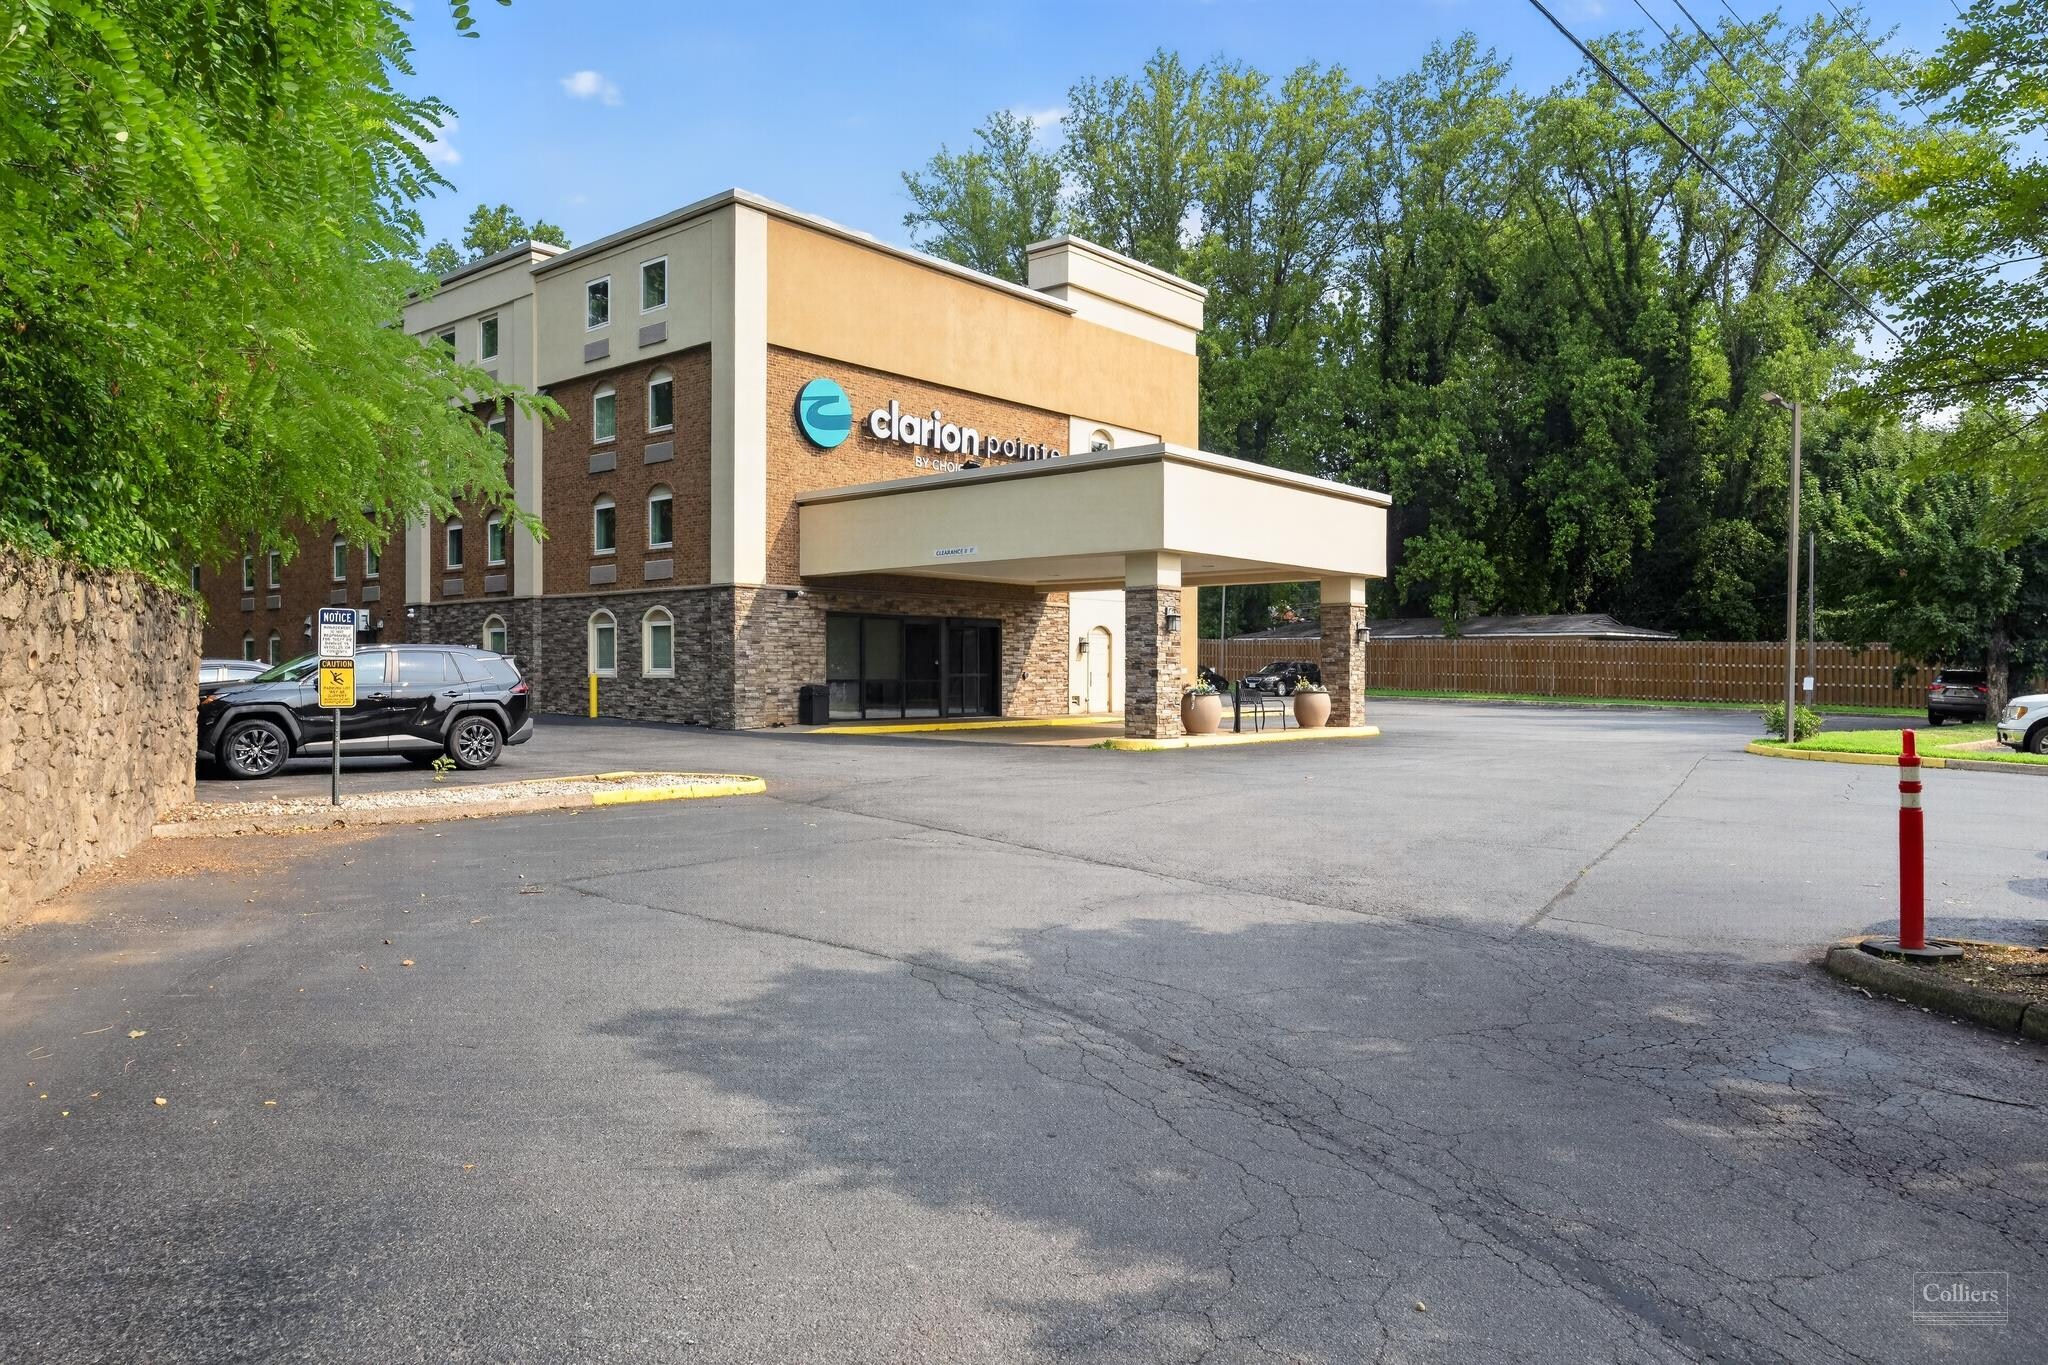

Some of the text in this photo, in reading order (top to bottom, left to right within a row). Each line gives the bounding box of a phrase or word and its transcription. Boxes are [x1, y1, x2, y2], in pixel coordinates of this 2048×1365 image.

[869, 399, 980, 456] clarion
[915, 455, 965, 473] BY CHOIC
[935, 548, 964, 557] CLEARANCE
[323, 611, 352, 623] NOTICE
[322, 660, 353, 668] CAUTION
